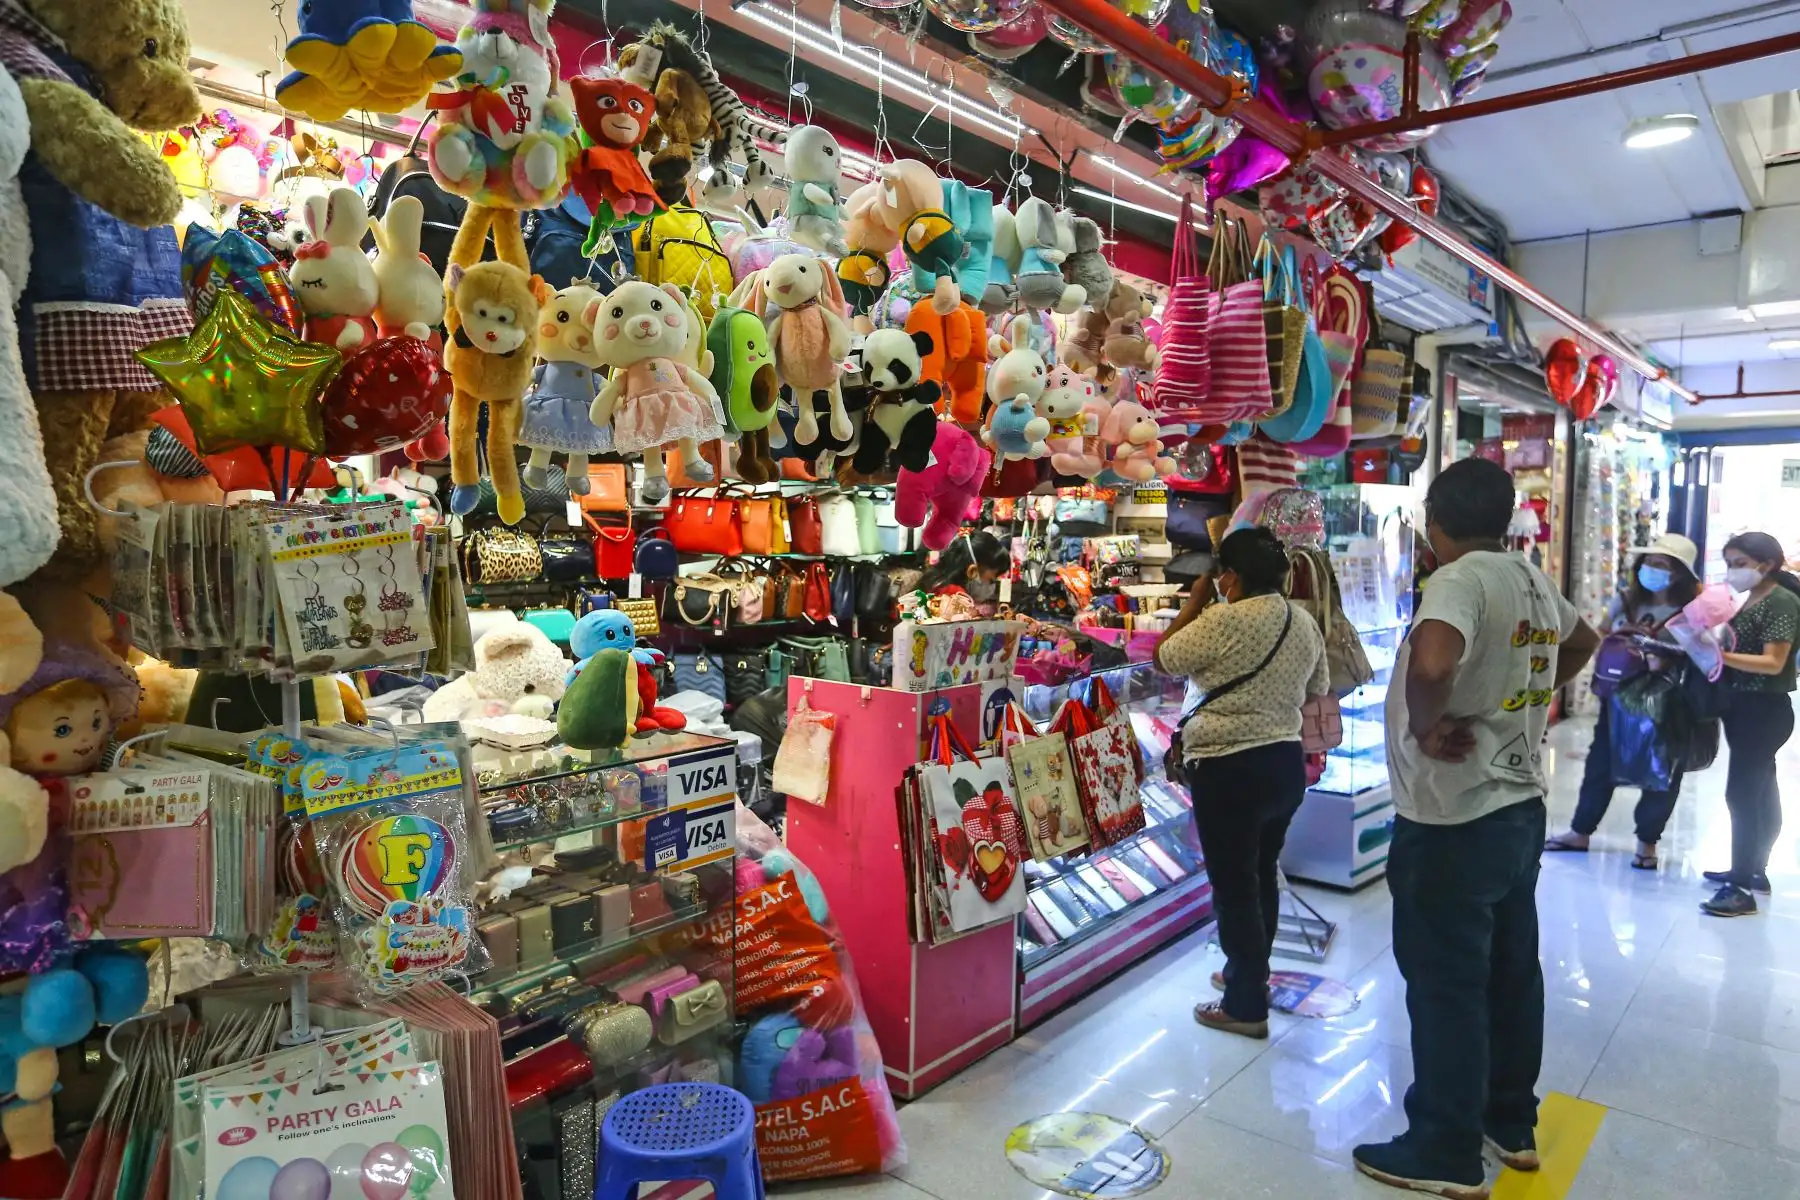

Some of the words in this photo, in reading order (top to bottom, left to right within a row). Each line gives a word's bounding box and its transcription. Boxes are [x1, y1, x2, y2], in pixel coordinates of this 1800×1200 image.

[510, 85, 530, 132] LOVE
[947, 626, 1017, 666] HAPPY
[676, 764, 728, 795] VISA
[379, 833, 432, 885] F
[658, 849, 675, 860] VISA
[741, 881, 793, 917] S.A.C.
[711, 920, 755, 944] NAPA
[735, 941, 782, 968] RENDIDOR
[774, 970, 785, 982] de
[786, 954, 821, 977] peluche
[267, 1106, 338, 1133] PARTY
[345, 1095, 403, 1118] GALA
[801, 1087, 856, 1120] S.A.C.
[278, 1130, 310, 1141] Follow
[313, 1124, 340, 1135] one's
[342, 1113, 396, 1129] inclinations
[765, 1126, 810, 1142] NAPA
